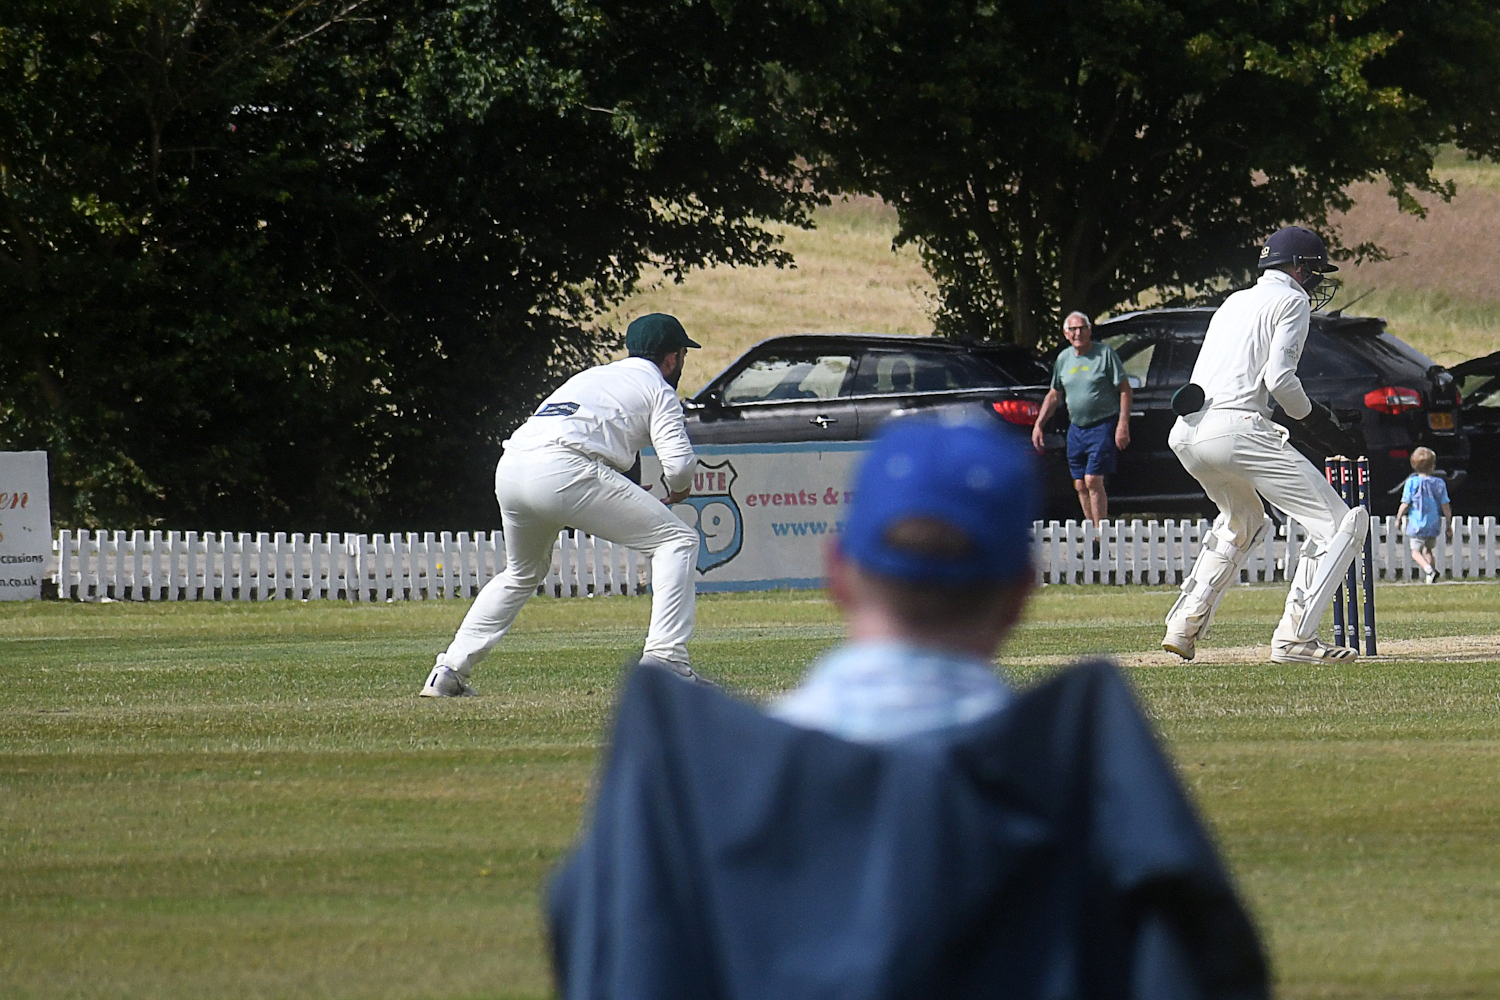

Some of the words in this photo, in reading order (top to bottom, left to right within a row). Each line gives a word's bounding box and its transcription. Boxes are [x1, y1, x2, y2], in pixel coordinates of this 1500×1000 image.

[694, 472, 727, 491] UTE
[0, 492, 29, 509] en
[746, 489, 817, 507] events
[823, 487, 838, 505] &
[0, 553, 43, 564] ccasions
[0, 575, 38, 588] n.co.uk
